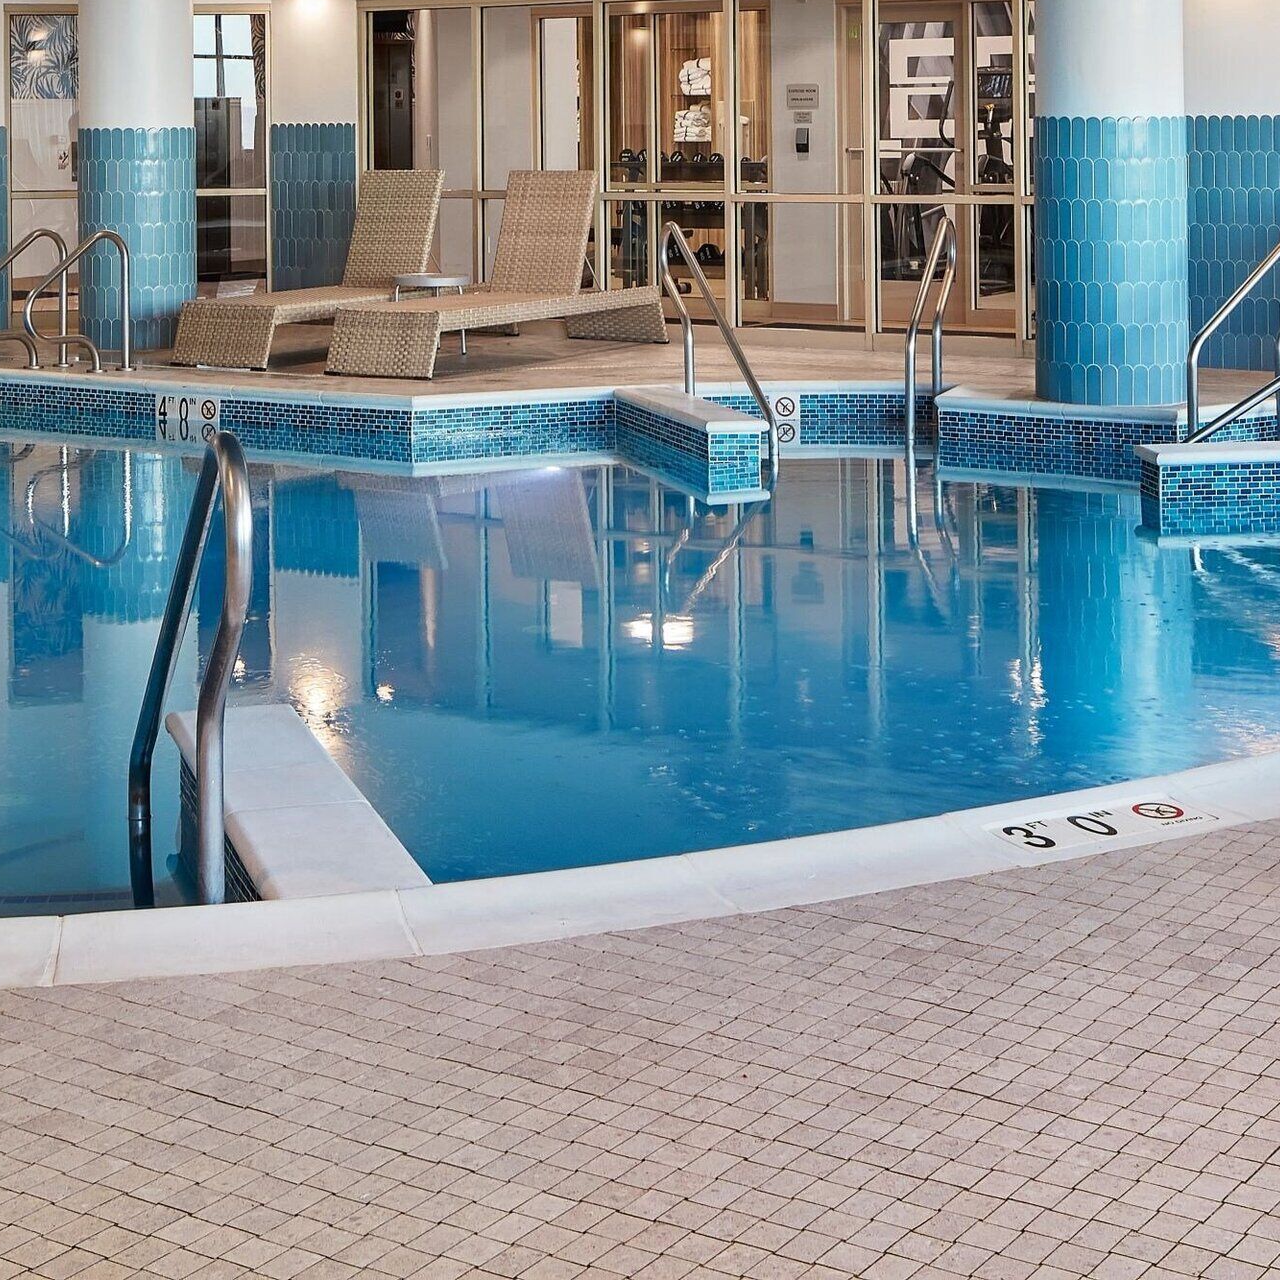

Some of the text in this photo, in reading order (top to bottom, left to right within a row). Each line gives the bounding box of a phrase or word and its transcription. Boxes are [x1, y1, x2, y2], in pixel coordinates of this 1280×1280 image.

[159, 394, 167, 420] 4
[179, 397, 188, 420] 0
[1002, 810, 1118, 848] 3 FT 0 IN
